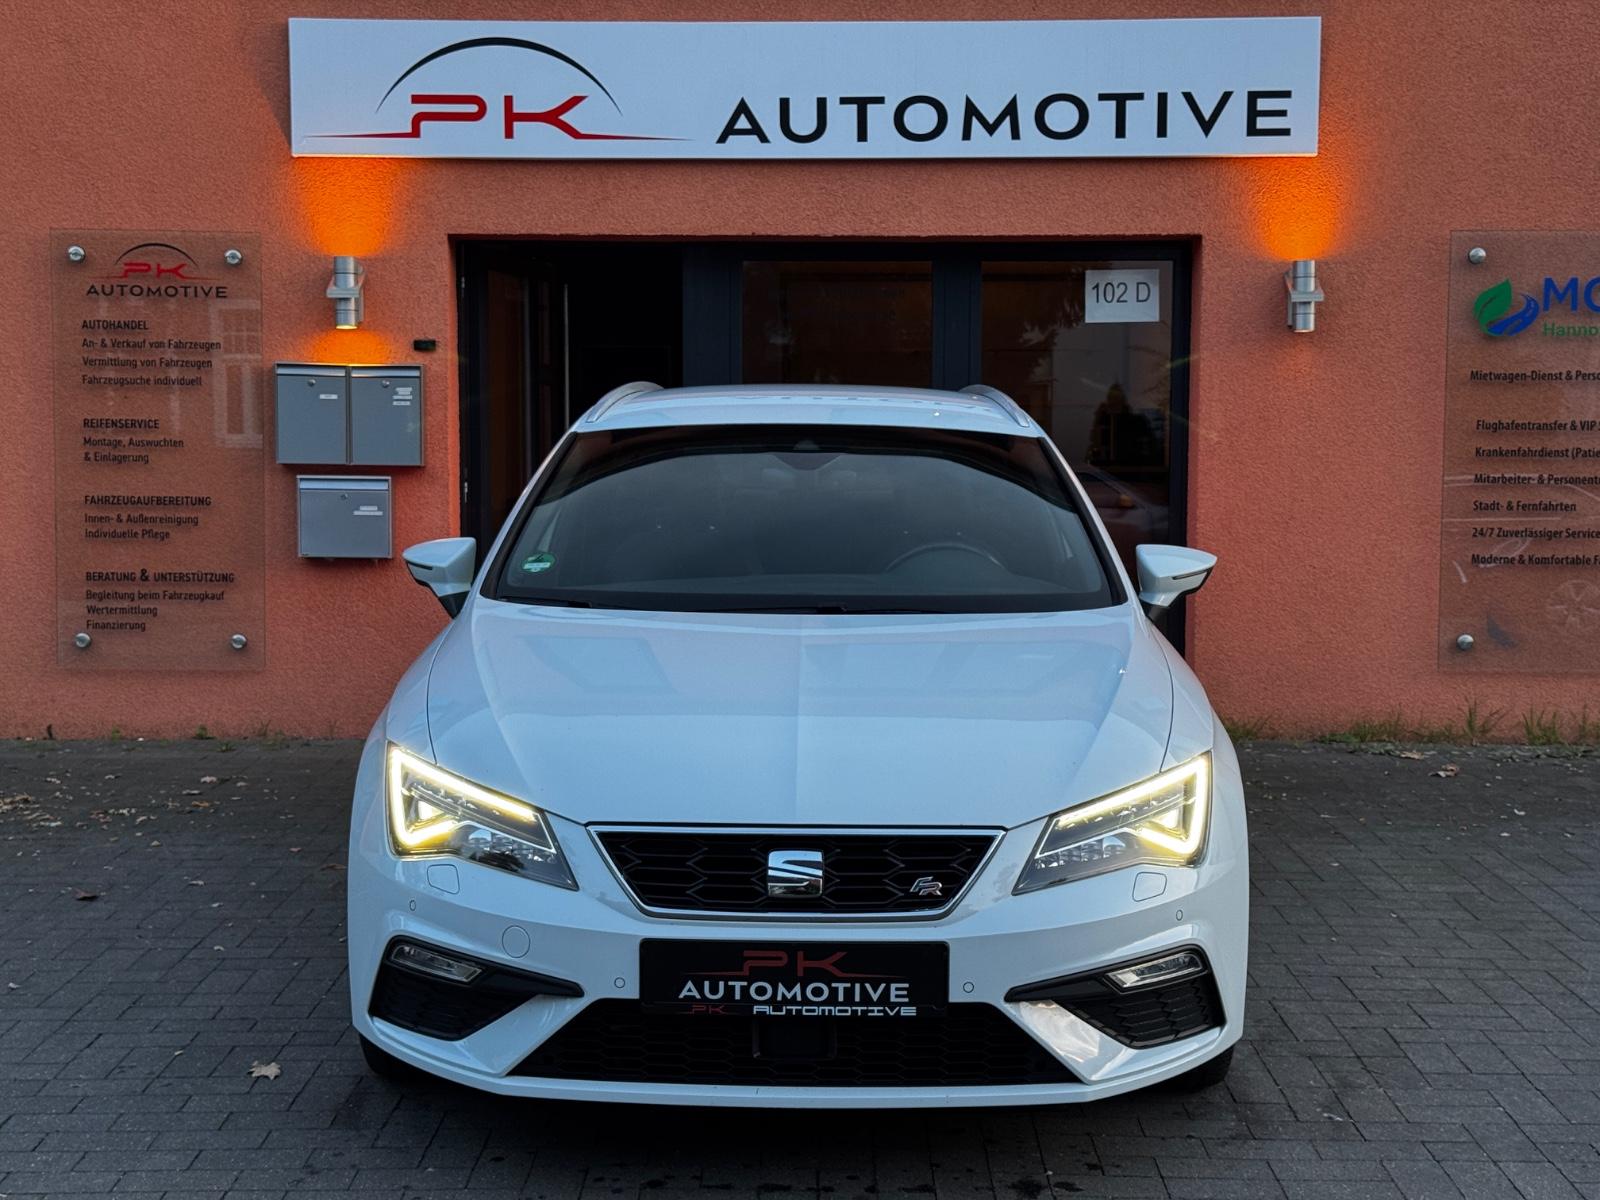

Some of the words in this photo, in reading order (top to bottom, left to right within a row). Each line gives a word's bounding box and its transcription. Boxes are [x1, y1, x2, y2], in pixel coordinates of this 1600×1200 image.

[411, 94, 590, 140] PK
[715, 90, 1292, 144] AUTOMOTIVE
[120, 262, 188, 280] PK
[86, 284, 228, 299] AUTOMOTIVE
[1091, 282, 1128, 303] 102
[1136, 282, 1151, 303] D
[81, 319, 149, 331] AUTOHANDEL
[81, 338, 98, 349] An-
[100, 338, 108, 349] &
[111, 338, 146, 350] Verkauf
[149, 341, 165, 350] von
[168, 339, 222, 352] Fahrzeugen
[82, 356, 138, 369] Vermittlung
[140, 358, 157, 368] von
[159, 357, 213, 370] Fahrzeugen
[81, 374, 151, 387] Fahrzeugsuche
[153, 375, 203, 387] individuell
[1470, 369, 1562, 383] Mietwagen-Dienst
[1565, 369, 1574, 381] &
[83, 418, 160, 430] REIFENSERVICE
[1476, 419, 1568, 433] Flughafentransfer
[1570, 419, 1577, 431] &
[1580, 419, 1597, 431] VIP
[83, 436, 126, 449] Montage,
[127, 436, 184, 448] Auswuchten
[83, 453, 92, 463] &
[94, 452, 150, 465] Einlagerung
[1475, 446, 1570, 459] Krankenfahrdienst
[1474, 473, 1536, 485] Mitarbeiter-
[1537, 473, 1545, 485] &
[84, 495, 212, 507] FAHRZEUGAUFBEREITUNG
[1473, 500, 1504, 512] Stadt-
[1506, 501, 1514, 512] &
[1516, 500, 1577, 513] Fernfahrten
[84, 513, 115, 525] Innen-
[116, 514, 124, 524] &
[126, 513, 199, 527] Außenreinigung
[84, 529, 140, 540] Individuelle
[141, 529, 171, 542] Pflege
[1472, 527, 1495, 539] 24/7
[1496, 527, 1564, 541] Zuverlässiger
[1471, 554, 1516, 566] Moderne
[1518, 554, 1527, 566] &
[1528, 554, 1592, 566] Komfortable
[86, 571, 136, 583] BERATUNG
[139, 568, 151, 583] &
[153, 569, 235, 583] UNTERSTÜTZUNG
[85, 590, 136, 603] Begleitung
[137, 590, 160, 601] beim
[162, 590, 226, 603] Fahrzeugkauf
[86, 605, 158, 617] Wertermittlung
[86, 620, 147, 632] Finanzierung
[742, 950, 848, 978] PK
[678, 979, 910, 1003] AUTOMOTIVE
[752, 1005, 917, 1017] AUTOMOTIVE
